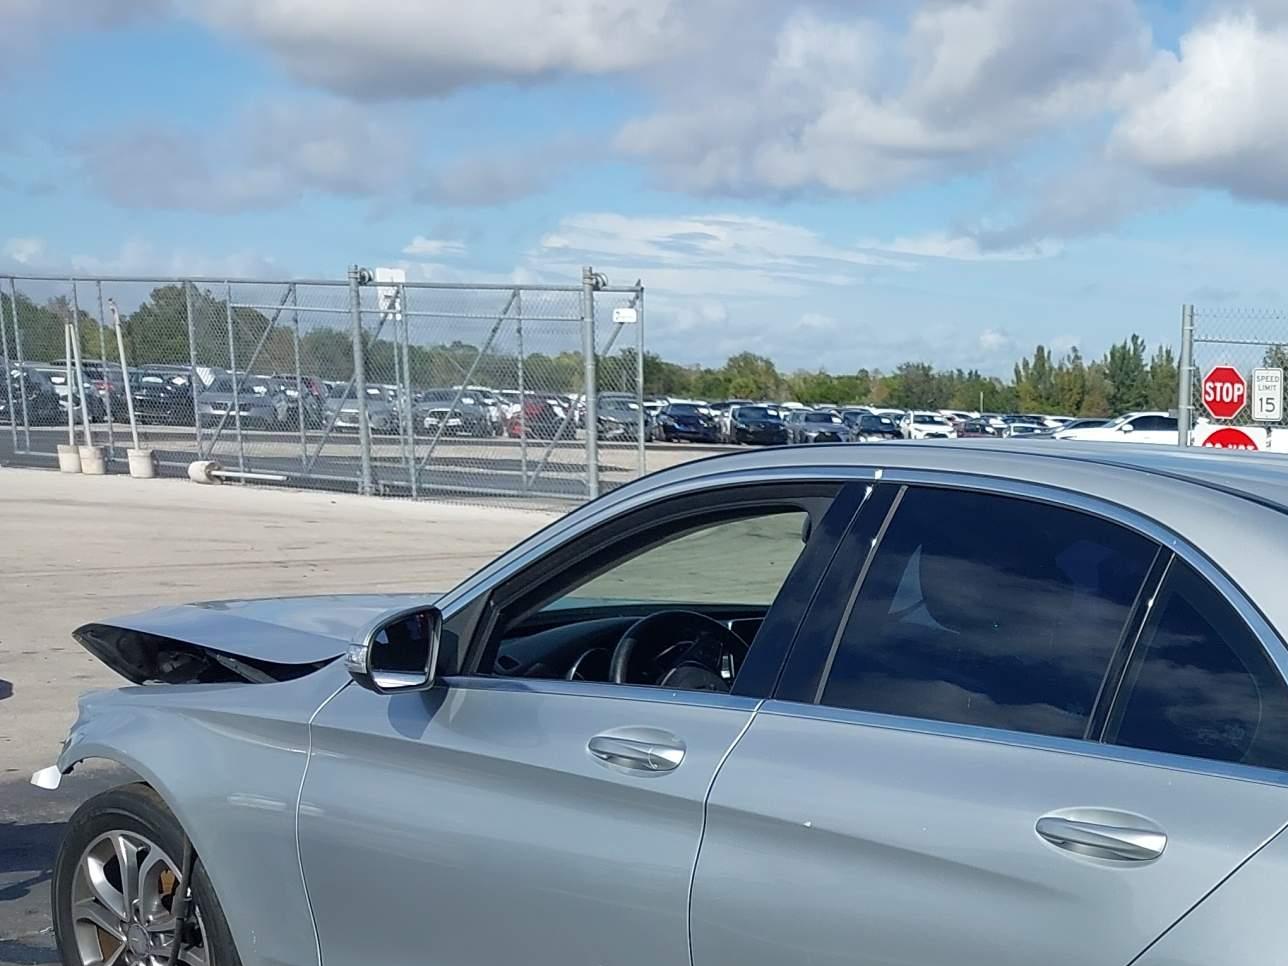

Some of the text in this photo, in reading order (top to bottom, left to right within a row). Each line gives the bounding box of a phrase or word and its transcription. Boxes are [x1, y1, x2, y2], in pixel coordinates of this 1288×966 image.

[1205, 382, 1244, 403] STOP
[1257, 384, 1277, 392] LIMIT
[1259, 397, 1276, 413] 15
